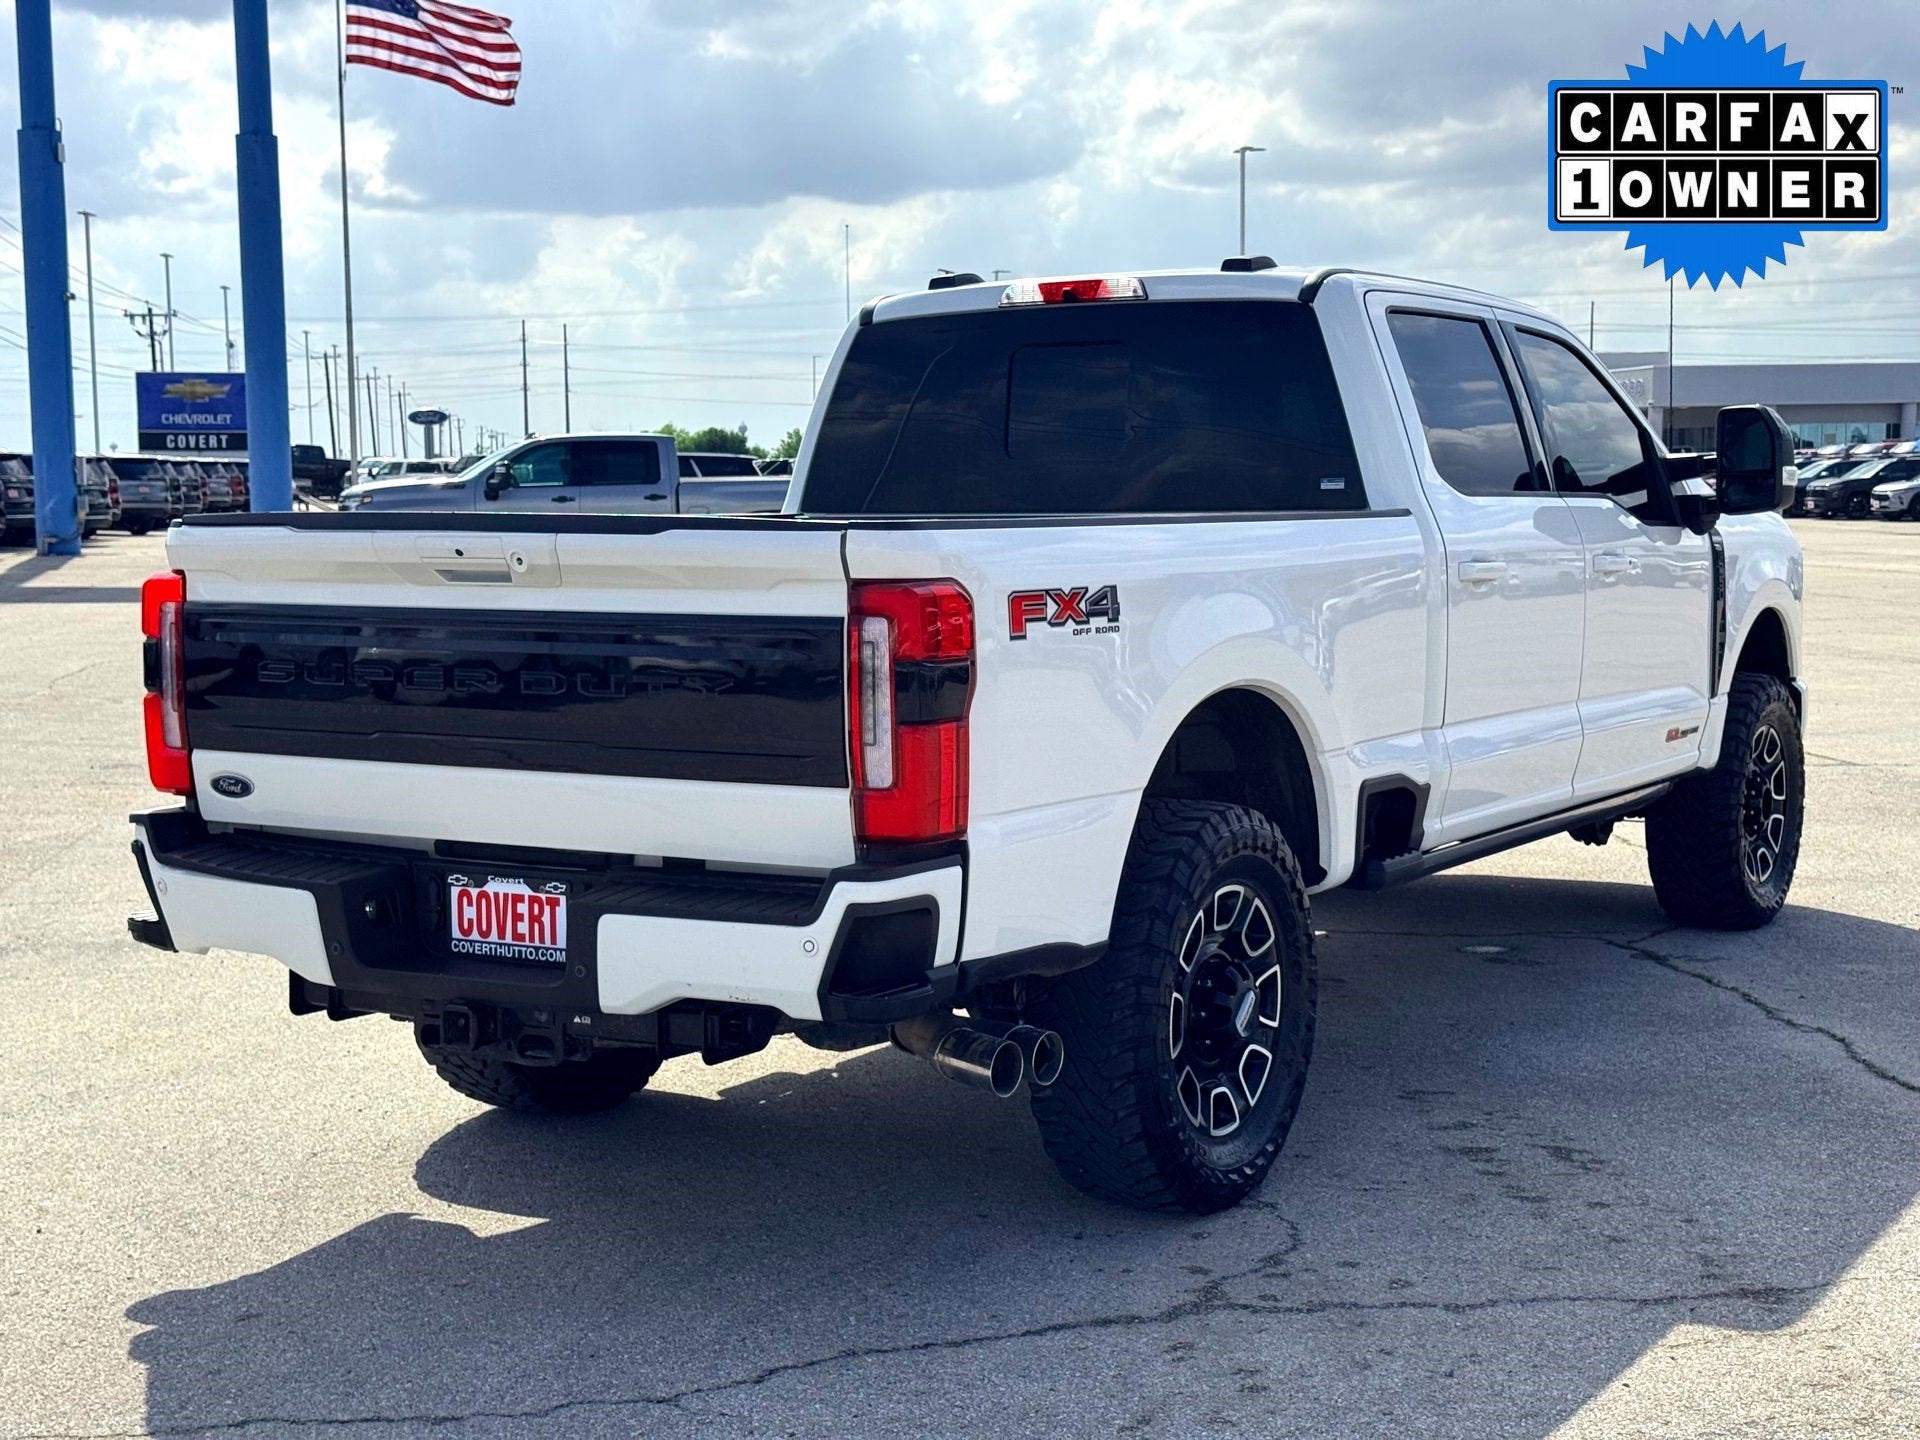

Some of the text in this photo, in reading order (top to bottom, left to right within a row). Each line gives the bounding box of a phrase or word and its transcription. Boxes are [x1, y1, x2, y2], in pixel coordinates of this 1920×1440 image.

[161, 413, 232, 425] CHEVROLET
[166, 434, 229, 449] COVERT
[1007, 584, 1121, 641] FX4
[1072, 625, 1120, 636] OFF ROAD
[257, 660, 735, 697] SUPER DUTY
[218, 777, 242, 793] Ford
[487, 875, 524, 884] Covert
[456, 888, 561, 946] COVERT
[451, 940, 567, 962] COVERTHUTTO.COM
